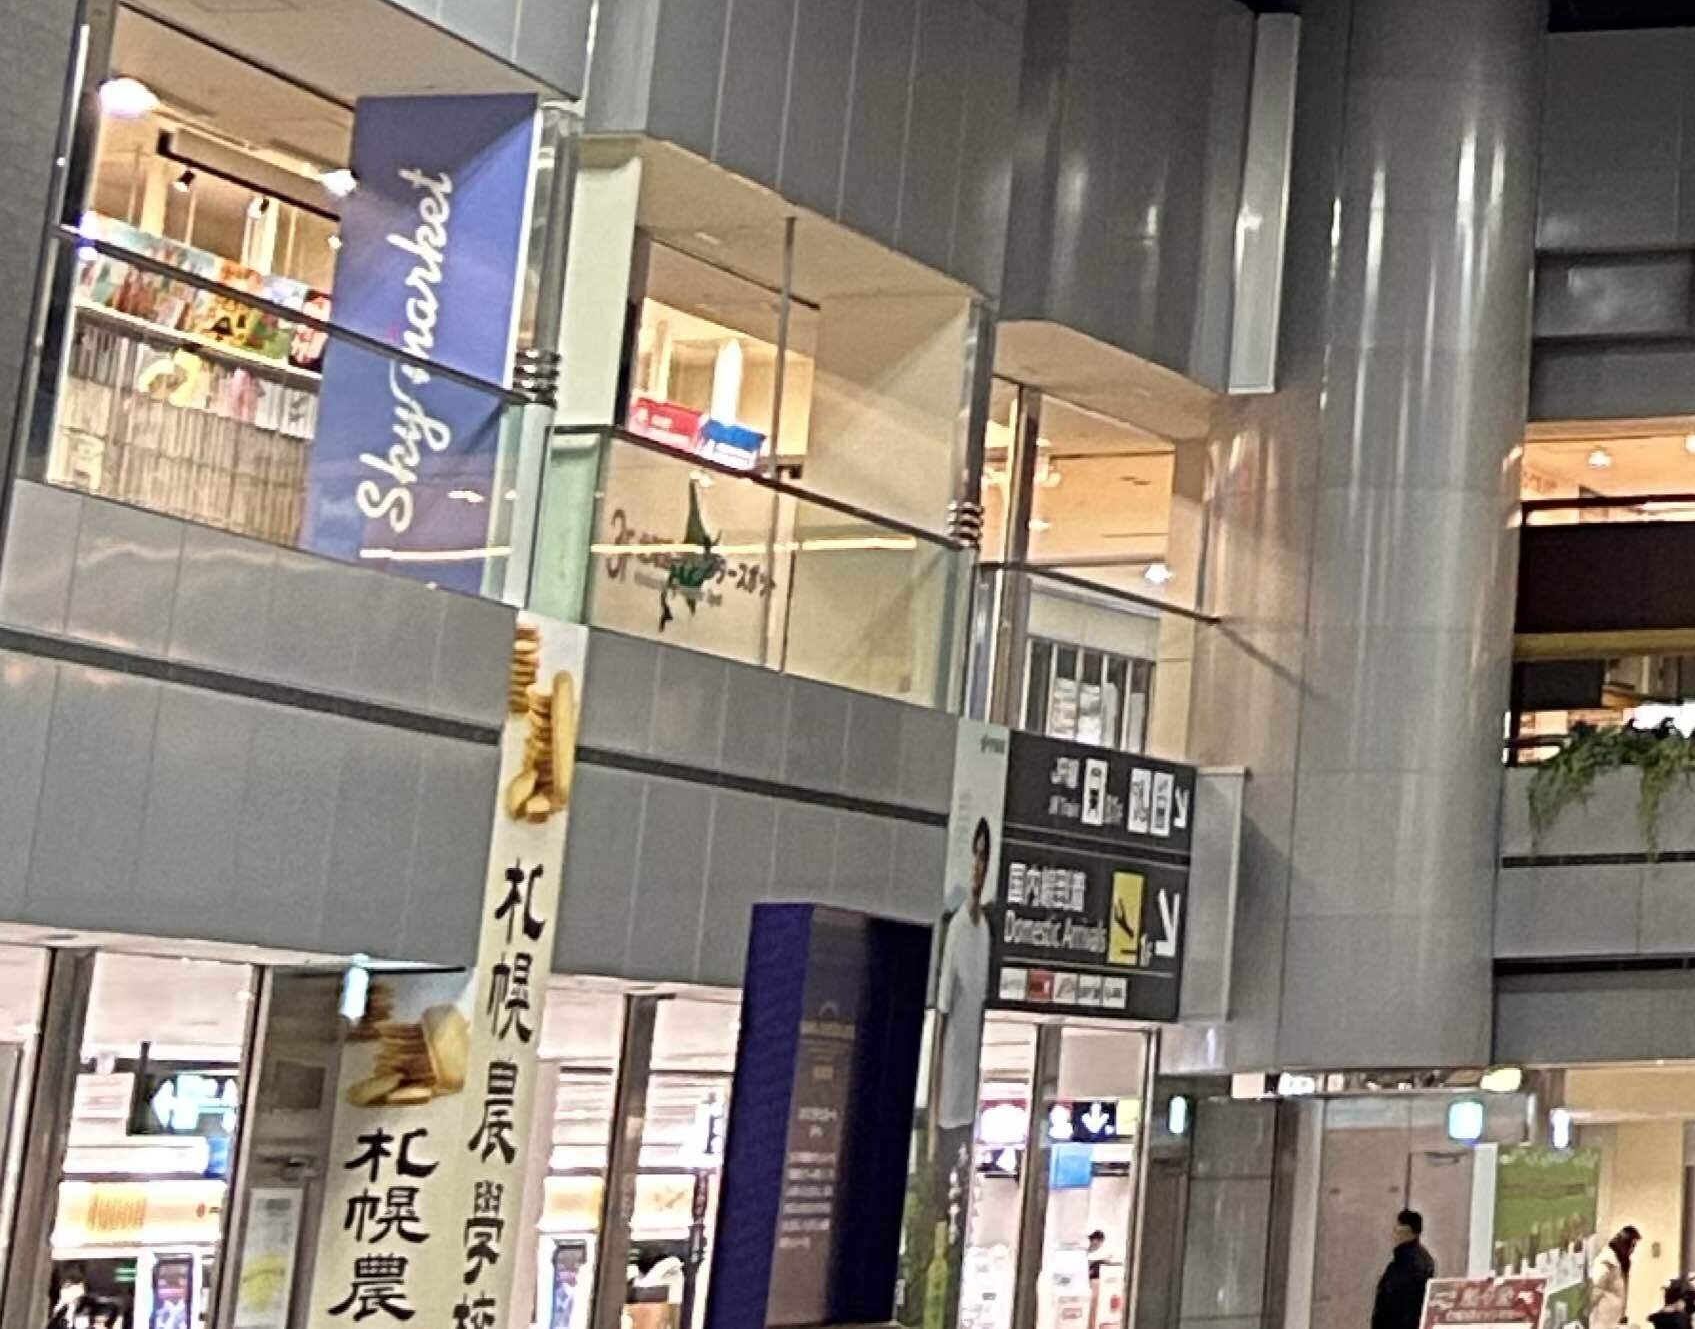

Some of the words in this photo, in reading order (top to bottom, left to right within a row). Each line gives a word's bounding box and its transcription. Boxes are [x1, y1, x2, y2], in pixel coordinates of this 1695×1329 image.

[385, 168, 453, 385] market
[328, 1127, 439, 1322] 札幌農
